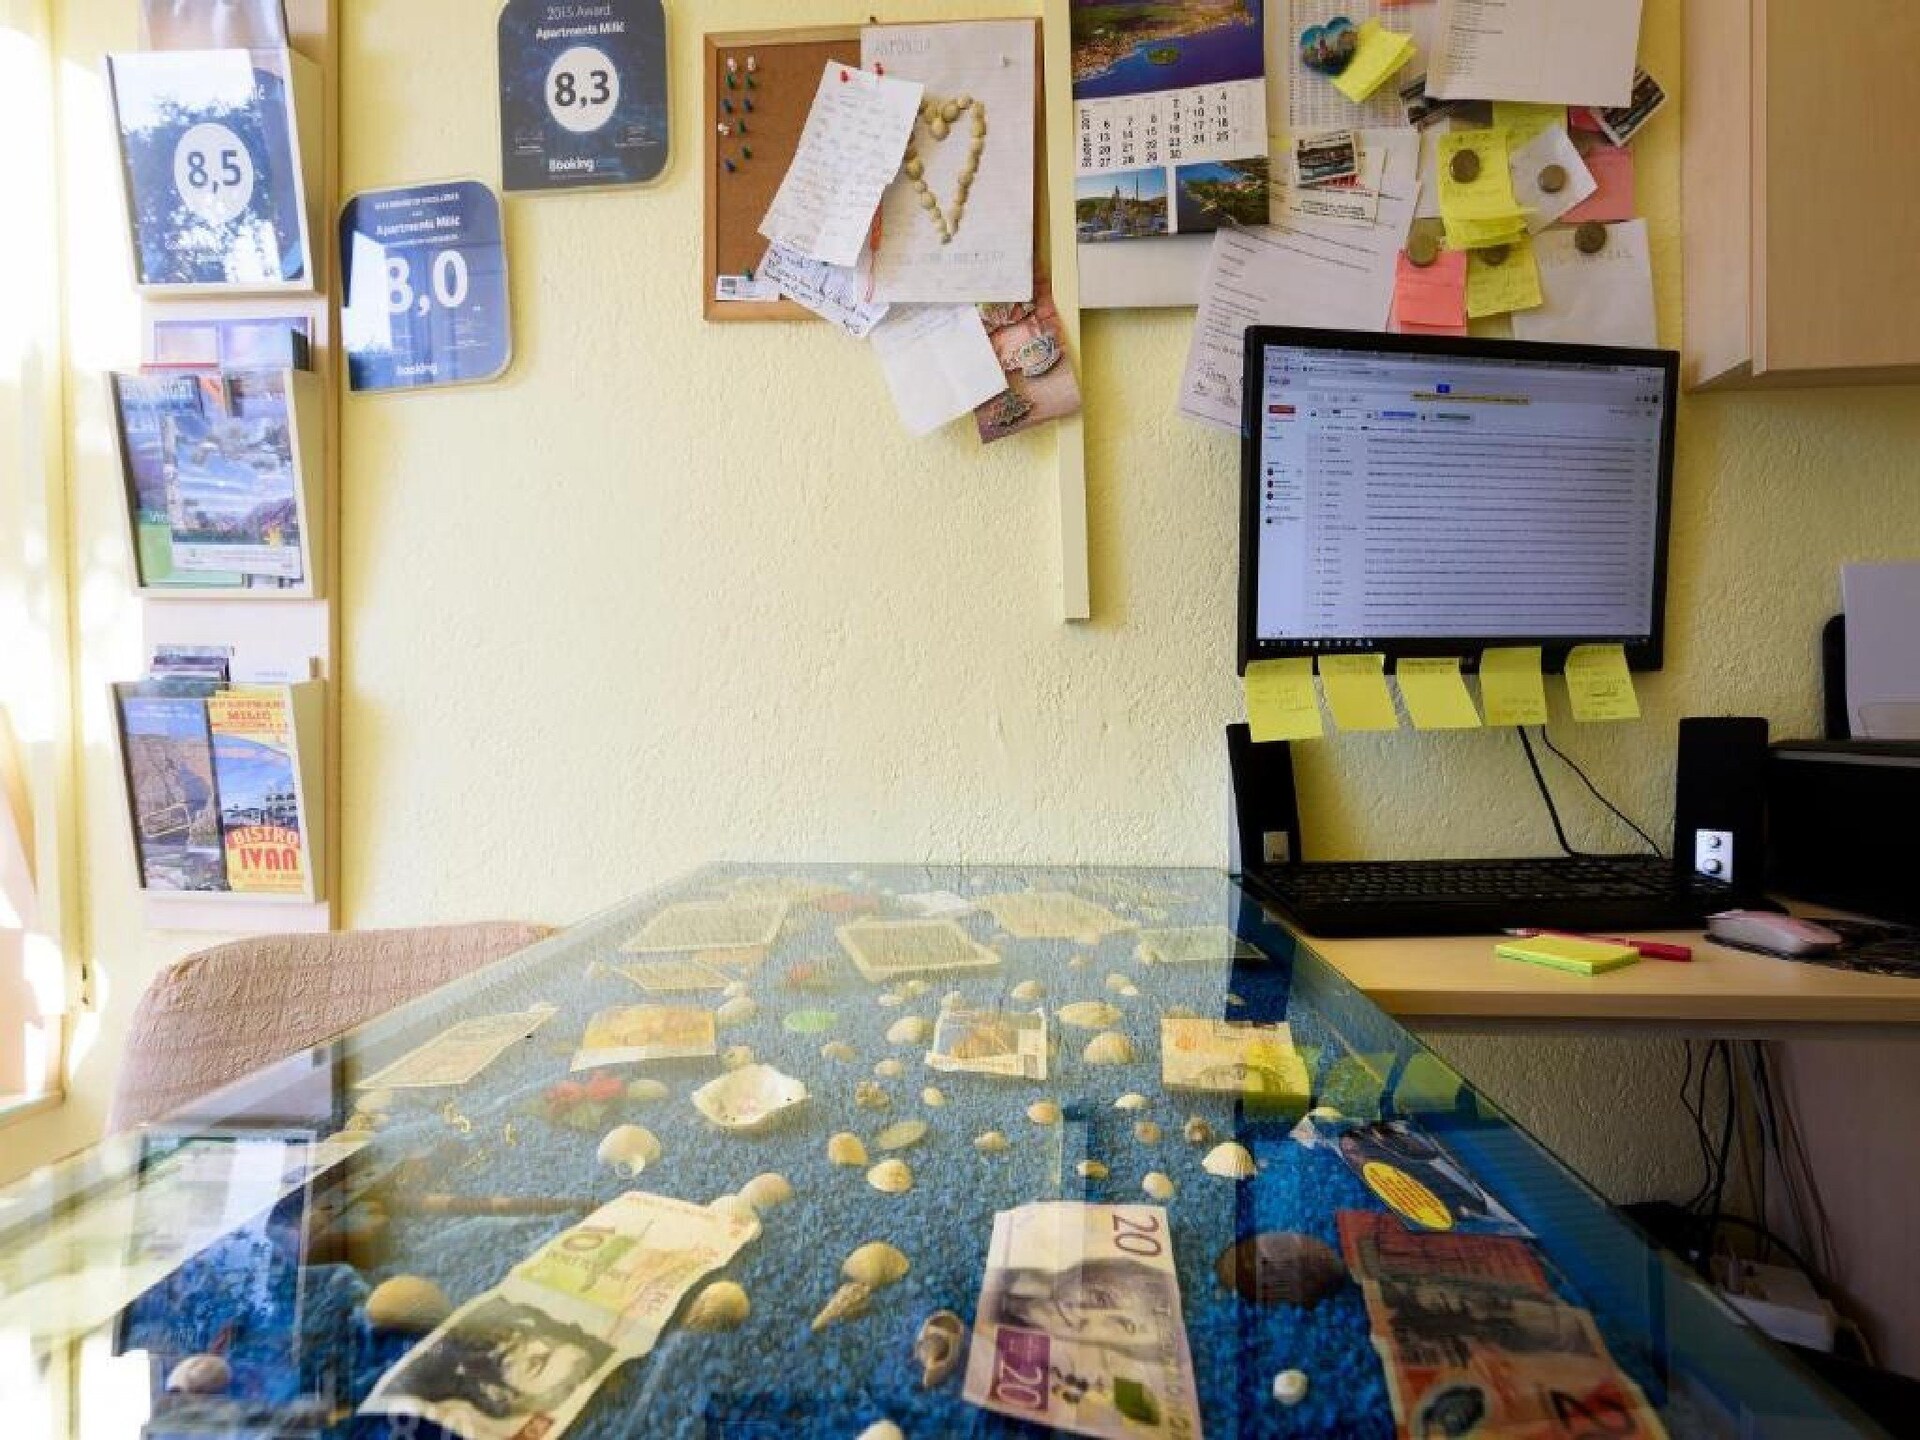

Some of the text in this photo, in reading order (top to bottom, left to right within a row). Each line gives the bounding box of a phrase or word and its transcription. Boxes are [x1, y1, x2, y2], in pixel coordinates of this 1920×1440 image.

[535, 25, 598, 41] Apartments
[555, 70, 611, 108] 8,3
[188, 150, 242, 193] 8,5
[386, 249, 468, 316] 8,0
[1112, 1213, 1162, 1257] 20
